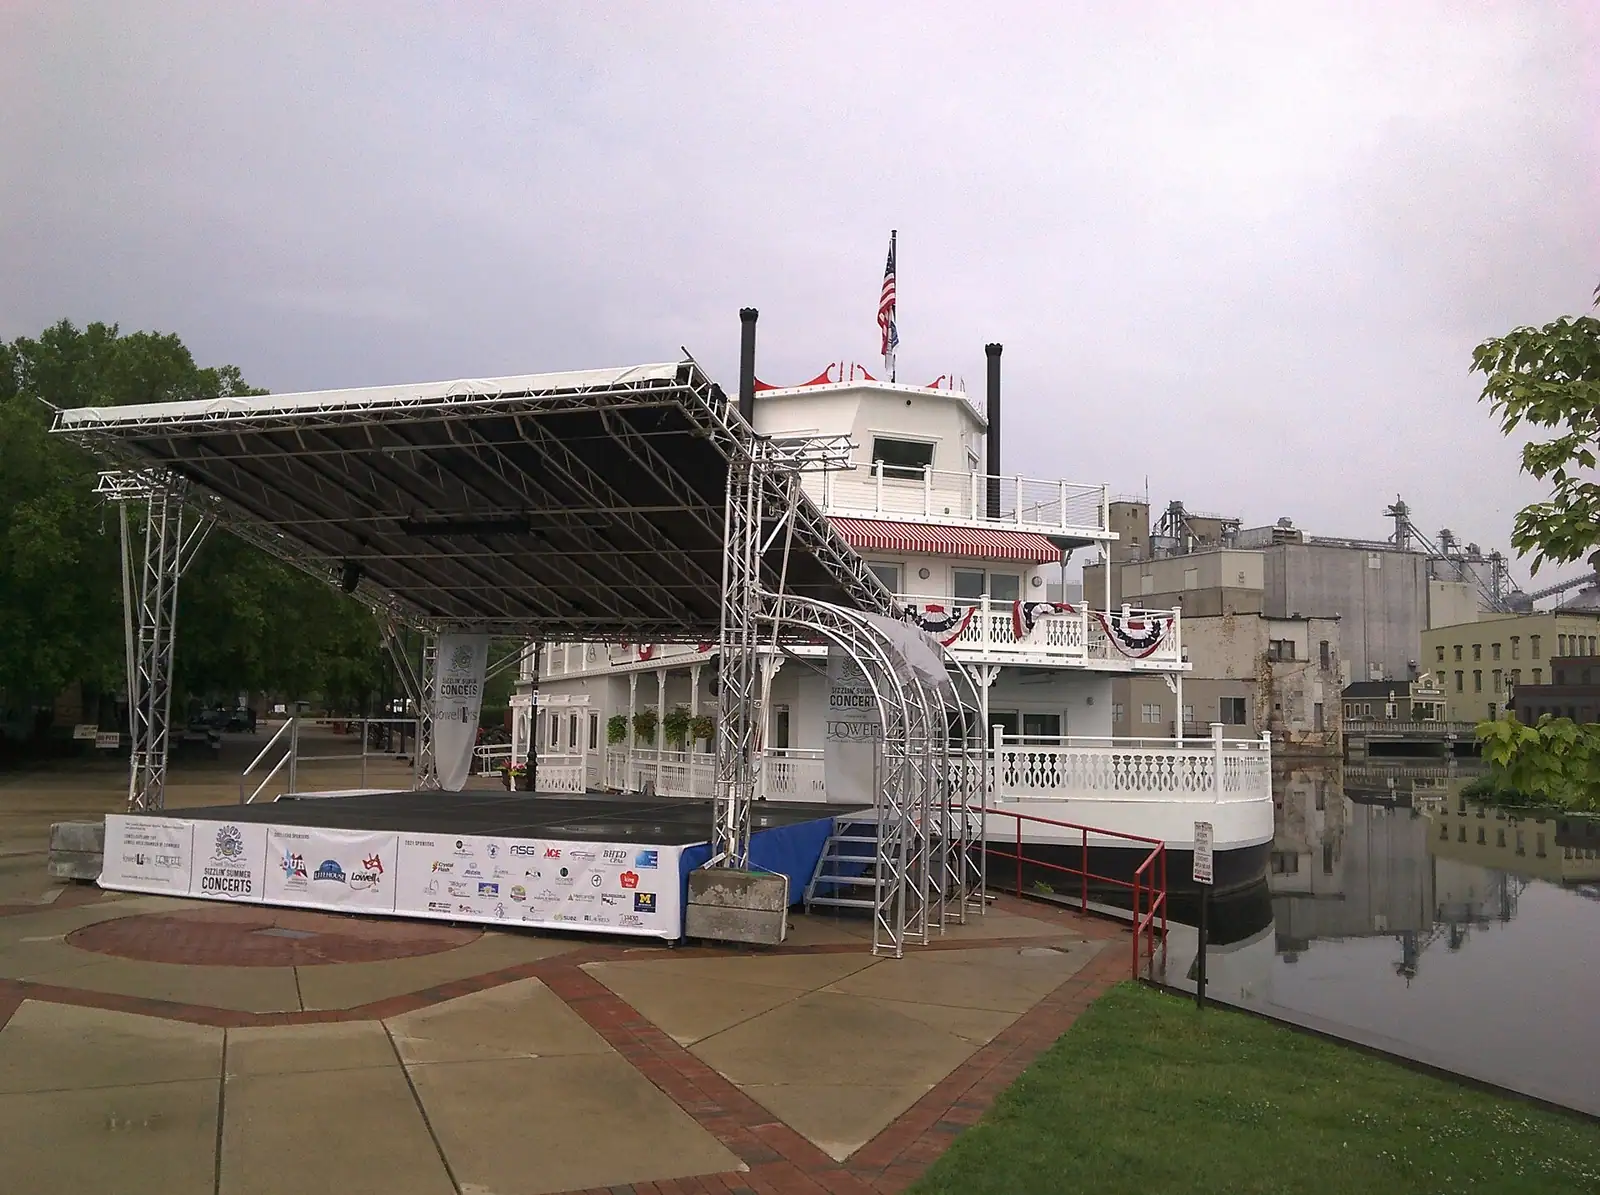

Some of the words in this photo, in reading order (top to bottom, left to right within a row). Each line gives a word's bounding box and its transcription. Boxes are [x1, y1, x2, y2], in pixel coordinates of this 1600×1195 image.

[829, 694, 879, 707] CONCERT
[509, 845, 535, 856] ASG
[543, 847, 561, 859] ACE
[603, 849, 627, 859] BHTD
[204, 867, 226, 876] SIZZLIN'
[226, 868, 251, 879] SUMMER
[202, 876, 252, 893] CONCERTS
[639, 893, 651, 904] M
